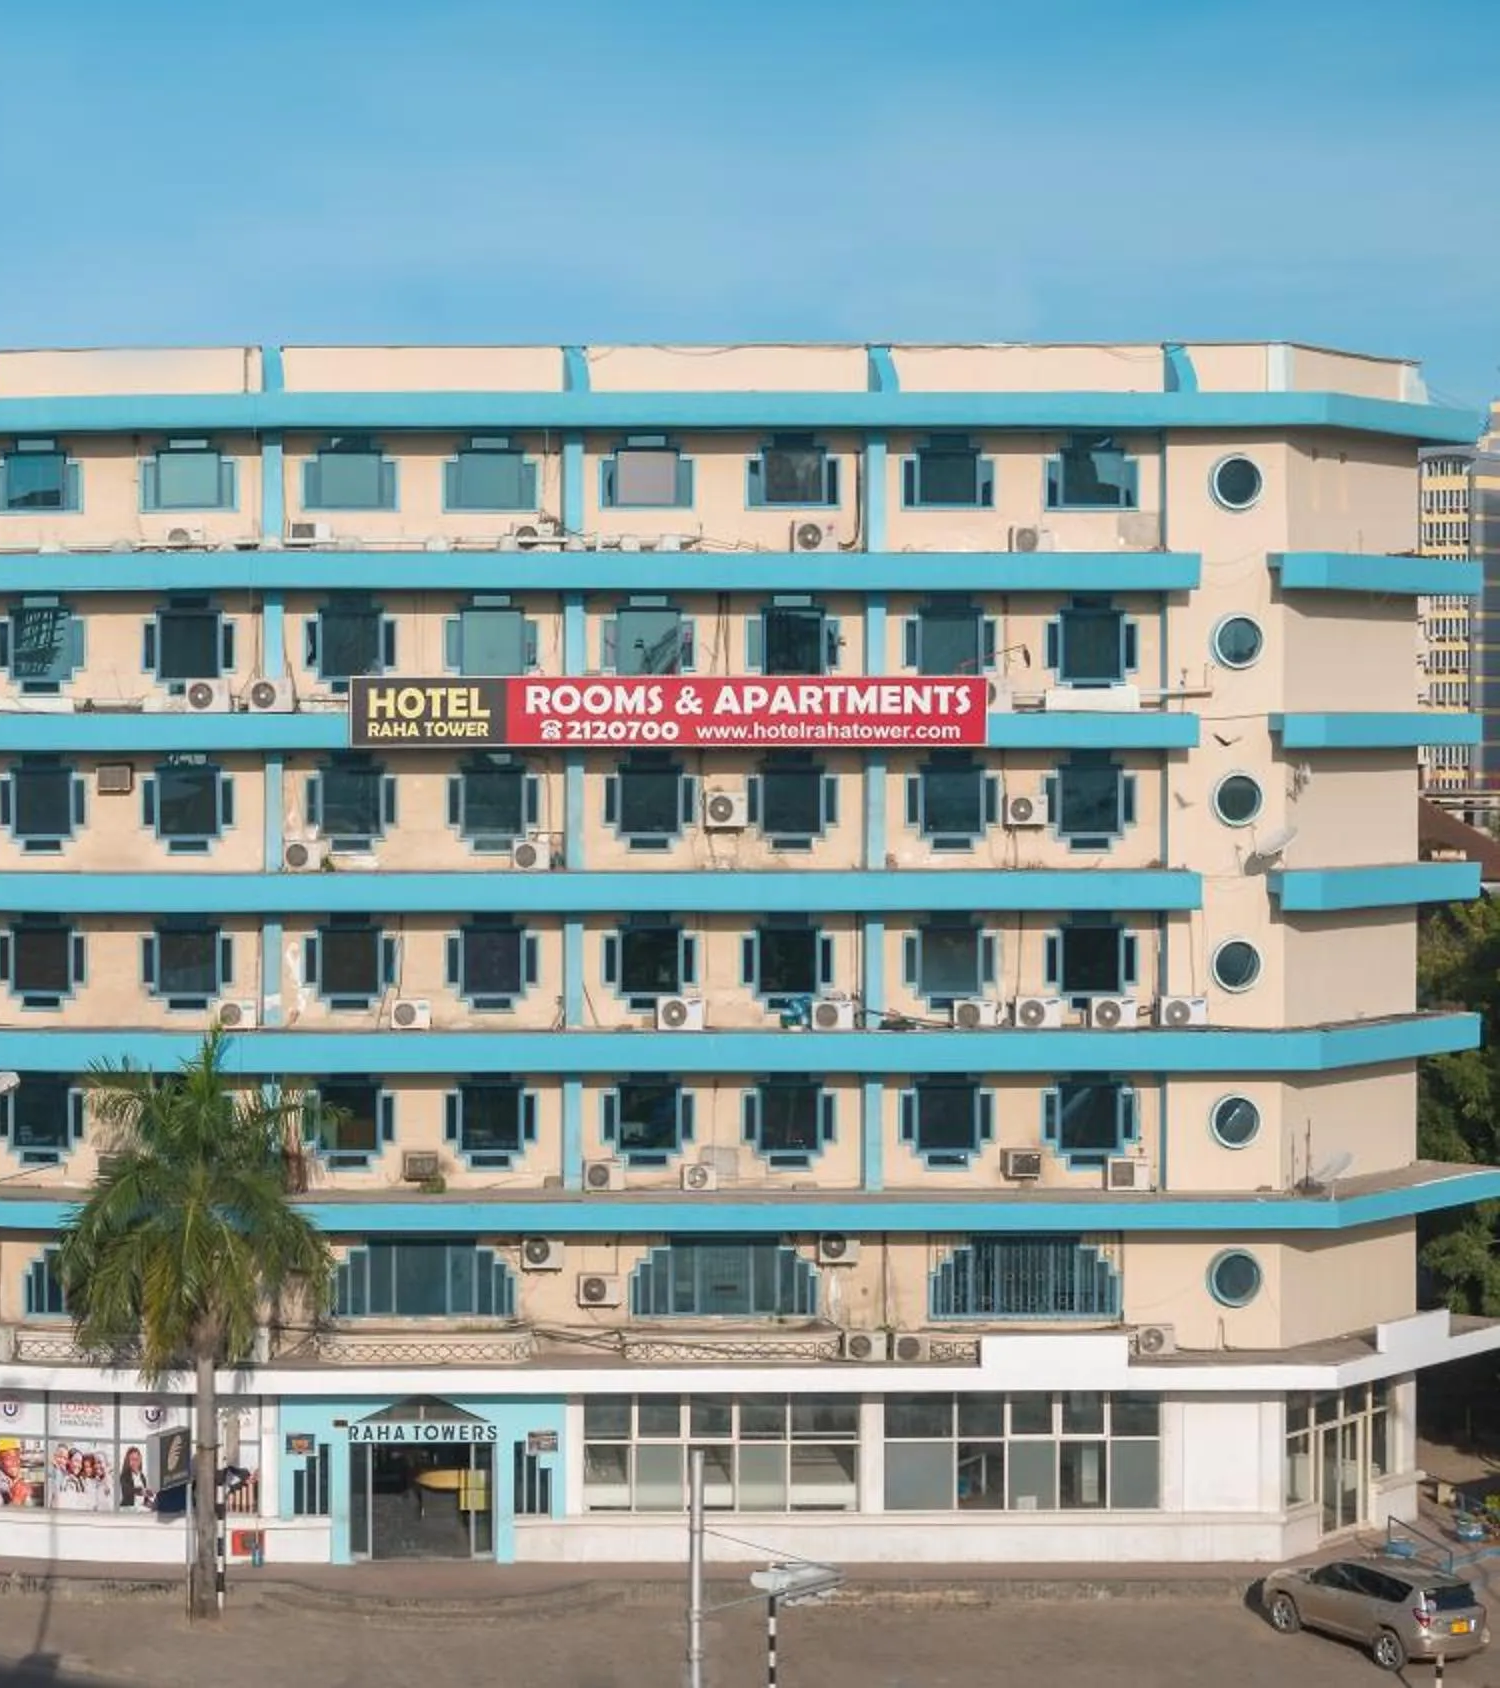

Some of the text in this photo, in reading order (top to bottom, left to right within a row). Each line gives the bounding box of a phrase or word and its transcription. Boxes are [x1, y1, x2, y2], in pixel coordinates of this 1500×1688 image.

[368, 688, 491, 718] HOTEL
[526, 685, 972, 715] ROOMS & APARTMENTS
[368, 722, 489, 737] RAHA TOWER
[567, 721, 680, 740] 2120700
[696, 721, 961, 739] www.hotelrahatower.com
[349, 1425, 498, 1441] RAHA TOWERS
